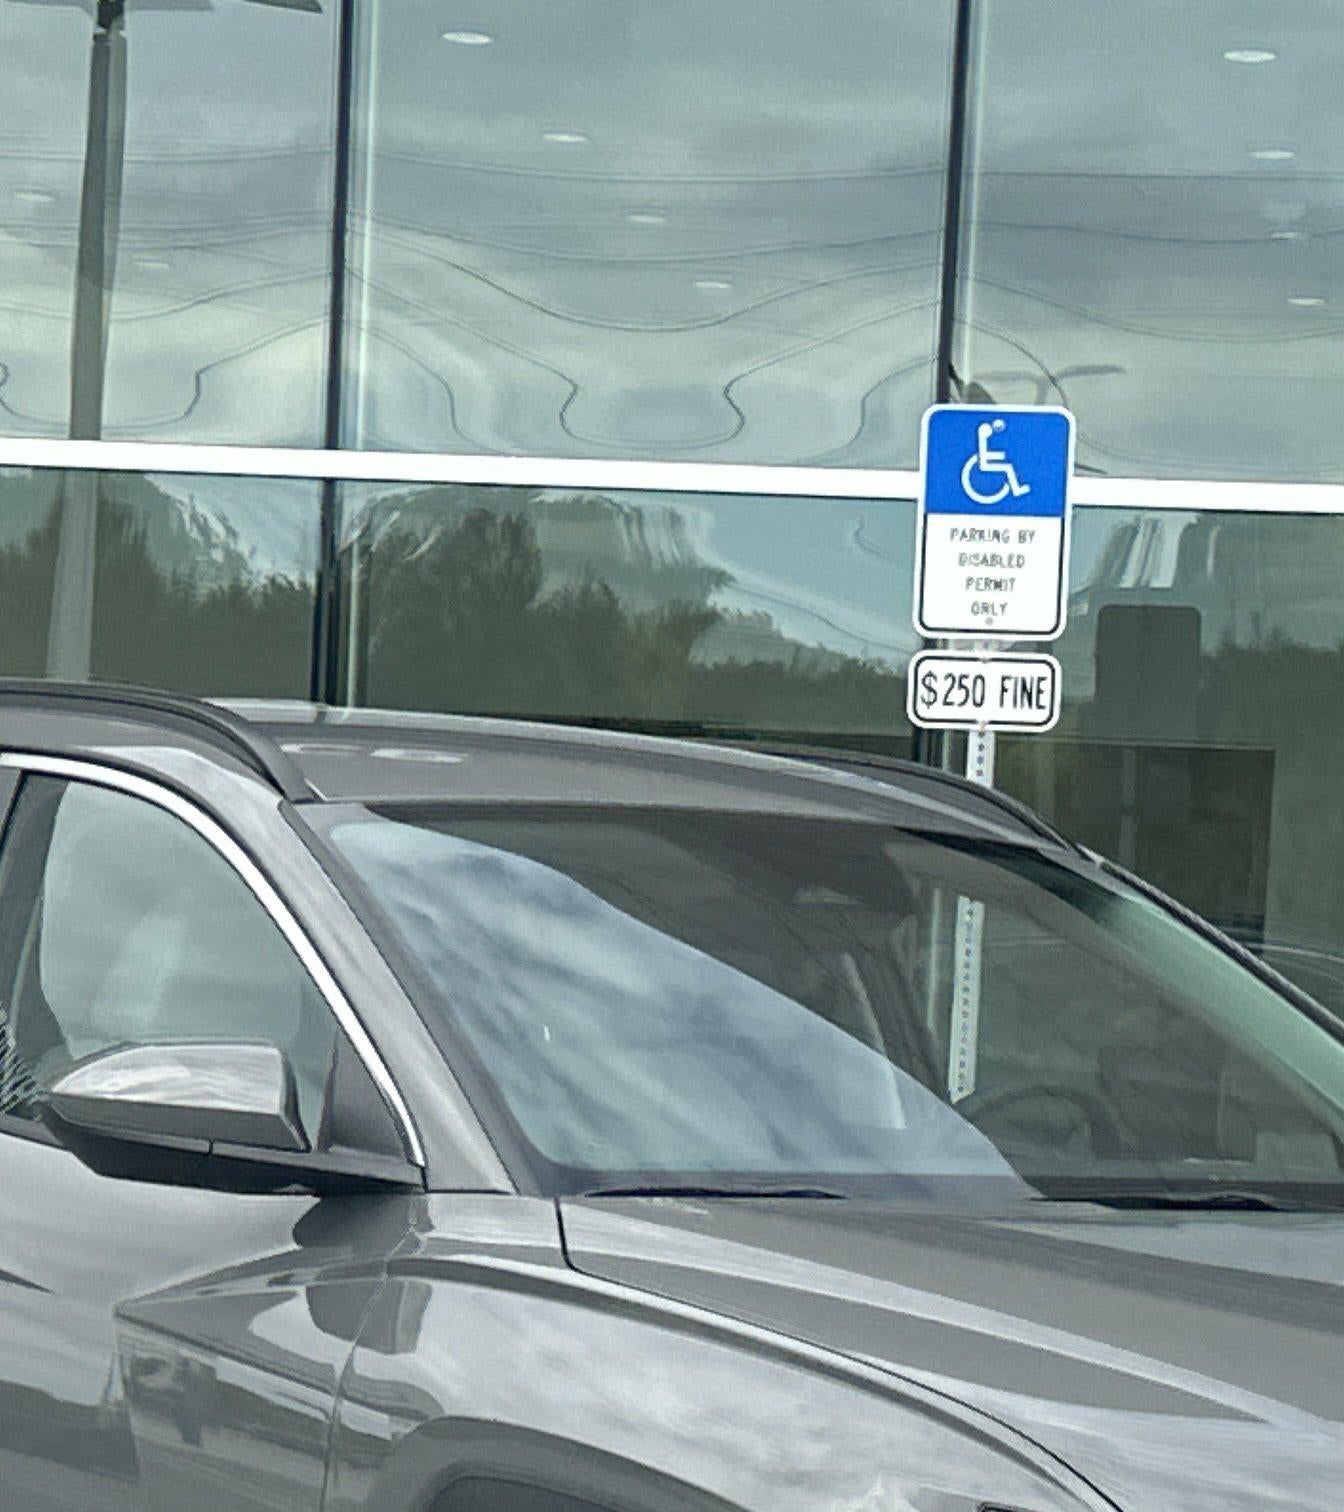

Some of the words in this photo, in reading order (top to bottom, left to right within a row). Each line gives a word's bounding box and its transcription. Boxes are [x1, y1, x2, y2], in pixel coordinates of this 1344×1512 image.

[950, 527, 1010, 544] PARKING
[1018, 529, 1035, 544] BY
[958, 552, 1025, 569] DISABLED
[965, 576, 1016, 592] PERMIT
[970, 600, 1008, 616] ONLY
[921, 671, 985, 709] $250
[999, 674, 1047, 709] FINE
